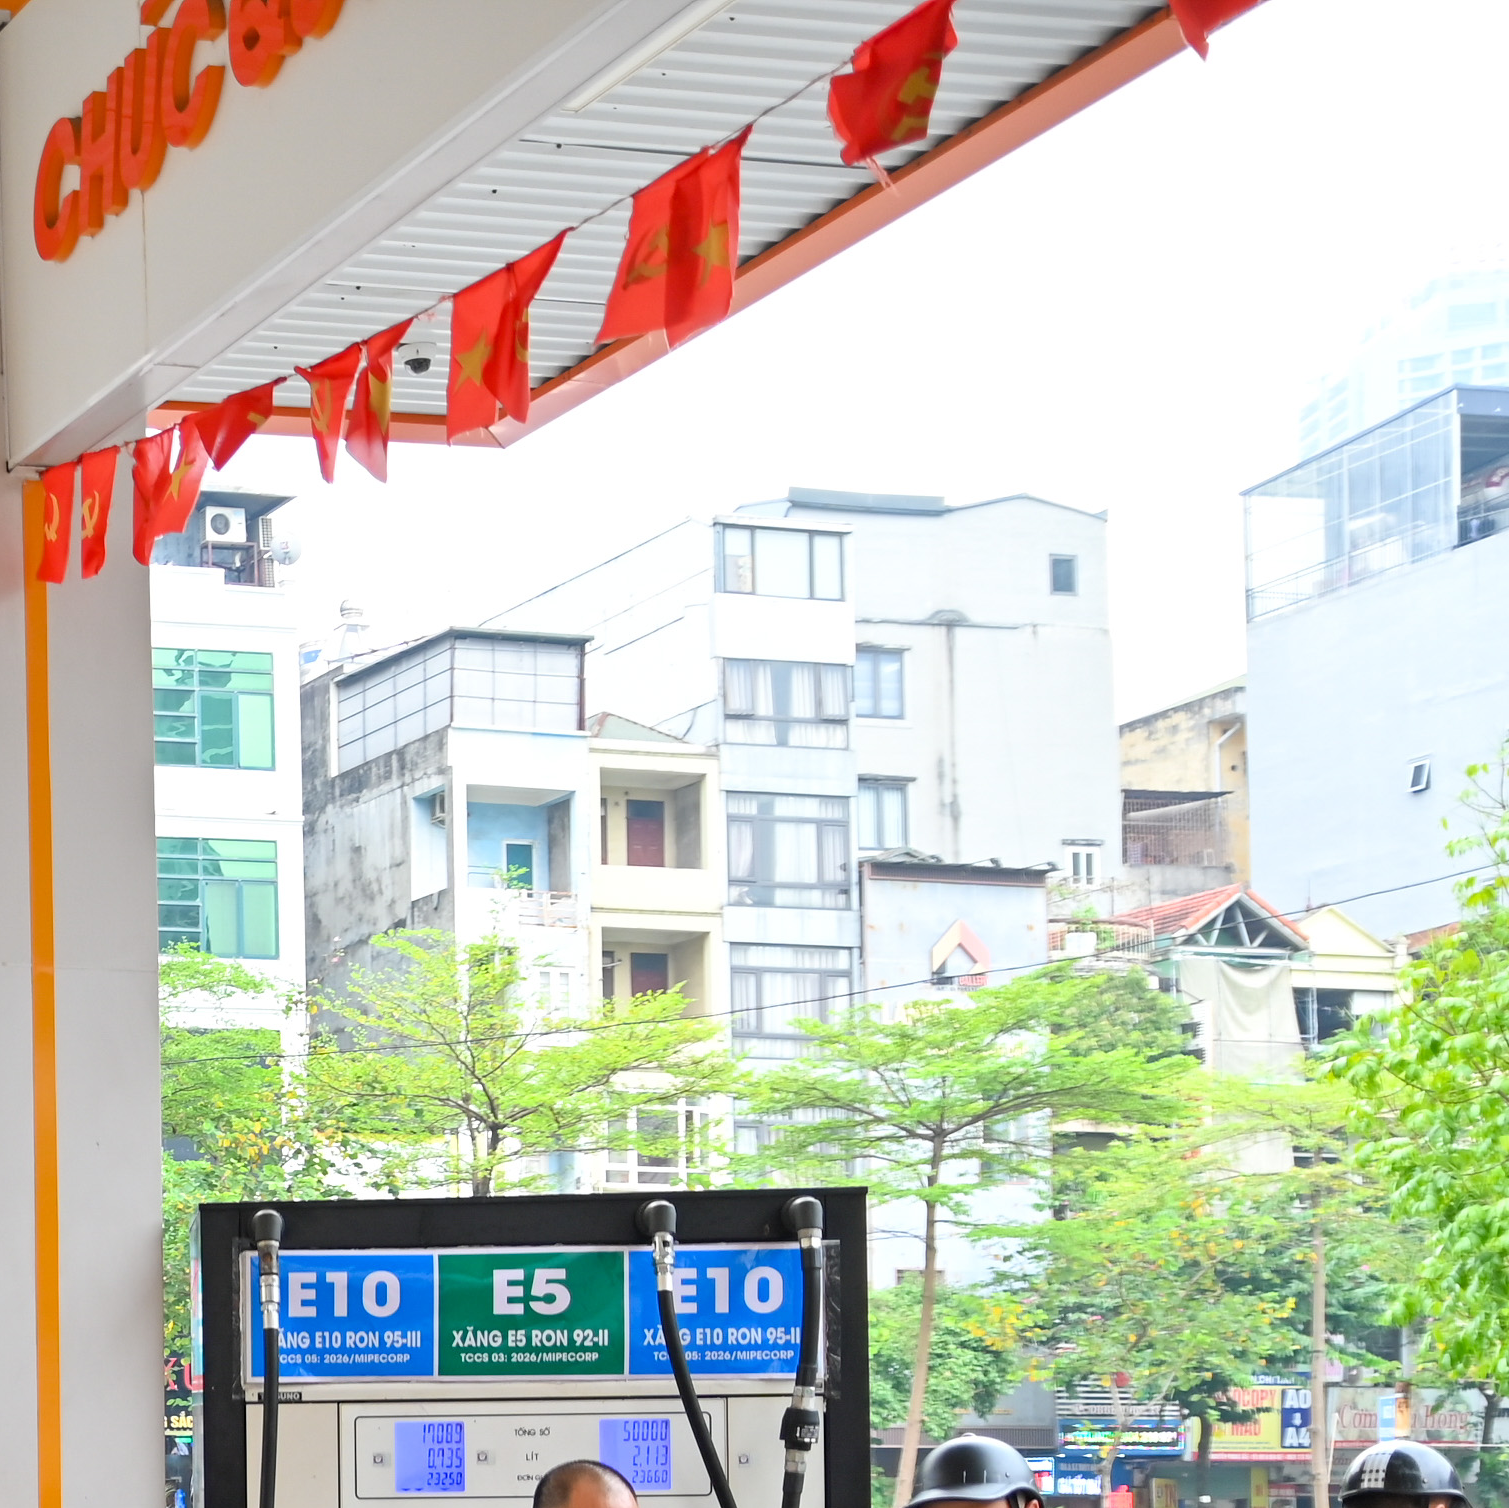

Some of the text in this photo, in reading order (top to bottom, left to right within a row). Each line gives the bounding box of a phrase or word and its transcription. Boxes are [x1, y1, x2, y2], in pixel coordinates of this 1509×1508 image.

[288, 1270, 400, 1317] E10
[493, 1268, 571, 1315] E5
[673, 1266, 783, 1313] E10
[278, 1328, 421, 1348] ĂNG E10 RON 95-III
[452, 1326, 609, 1348] XĂNG E5 RON 92-II
[696, 1328, 723, 1344] E10
[728, 1327, 762, 1344] RON
[766, 1326, 800, 1344] 95-II
[278, 1353, 410, 1364] CCS 05: 2026/MIPECORP
[461, 1352, 599, 1363] TCCS 03: 2026/MIPECORP
[705, 1350, 794, 1361] 2026/MIPECORP
[623, 1420, 668, 1442] 50000
[1282, 1427, 1311, 1448] A4
[525, 1451, 539, 1461] LÍT
[427, 1472, 462, 1486] 23250
[632, 1469, 668, 1484] 23660
